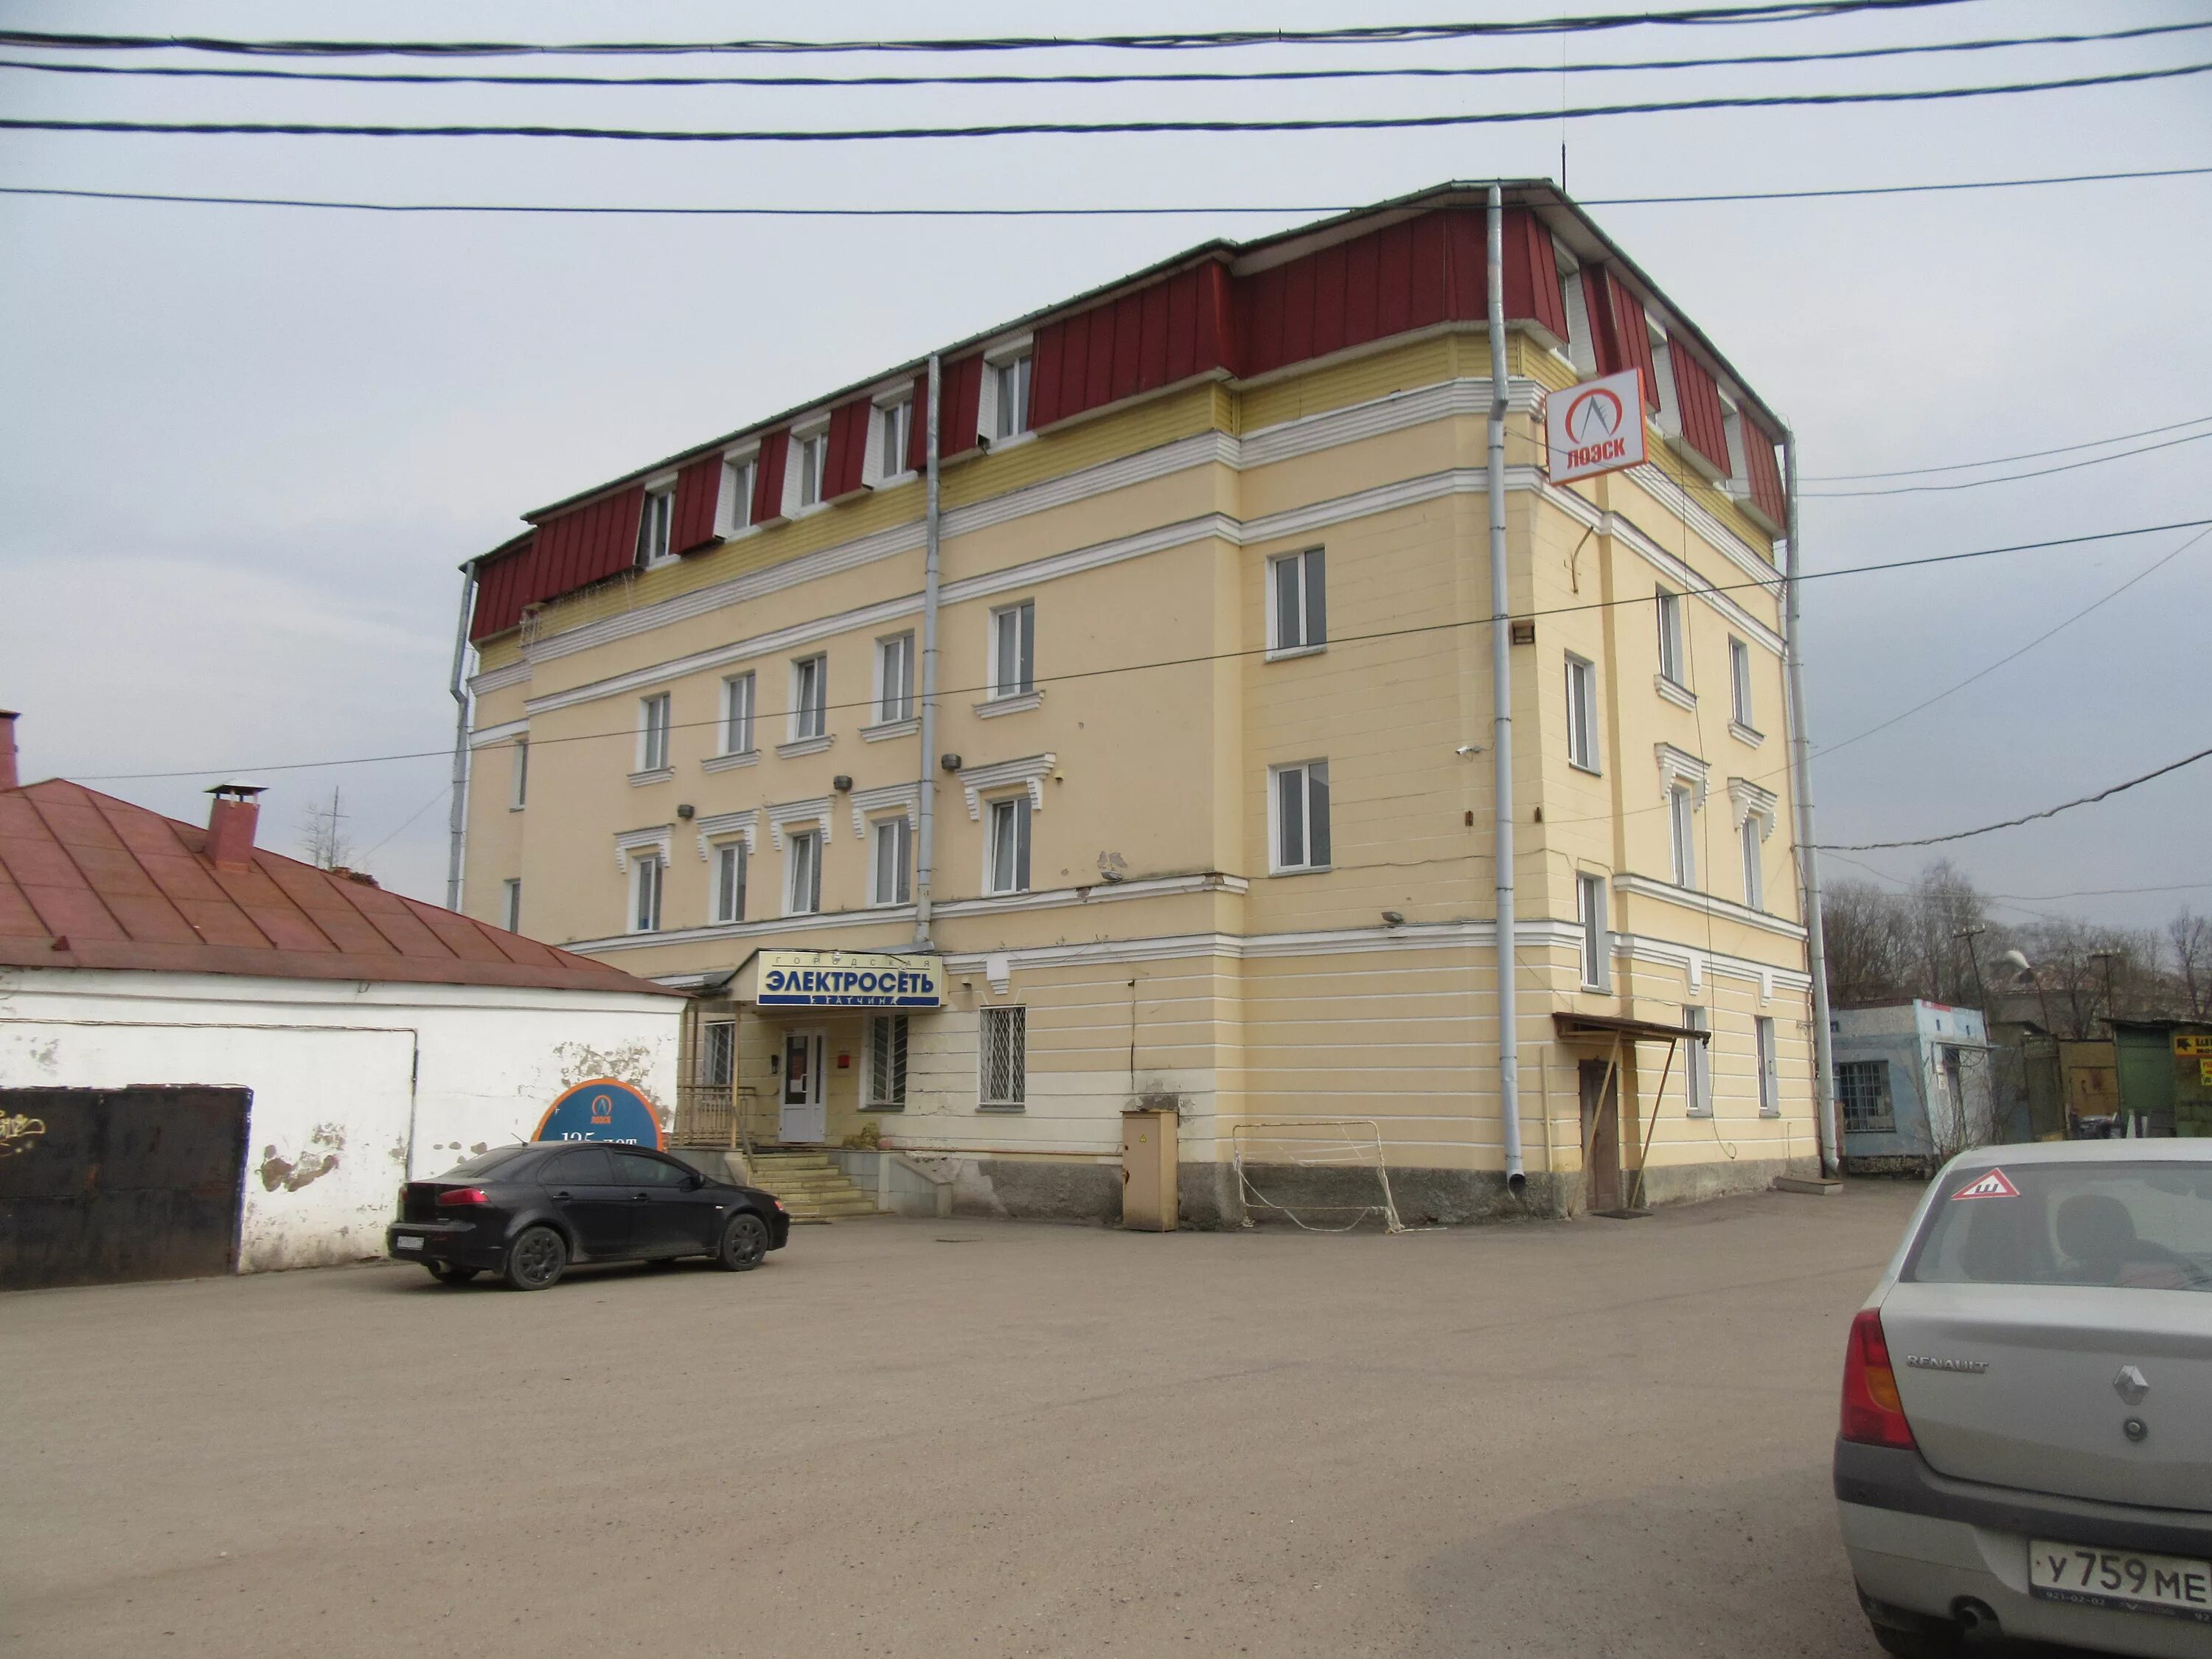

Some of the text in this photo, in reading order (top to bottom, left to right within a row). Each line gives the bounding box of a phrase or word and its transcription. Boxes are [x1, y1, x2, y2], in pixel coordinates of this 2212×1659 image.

[1568, 437, 1626, 469] ЛОЭСК
[776, 956, 930, 967] ГОРОДСКАЯ
[765, 970, 934, 993] ЭЛЕКТРОСЕТЬ
[827, 996, 897, 1005] ГАТЧИНА
[1975, 1183, 1999, 1194] Ш
[1906, 1354, 1989, 1374] RENAULT
